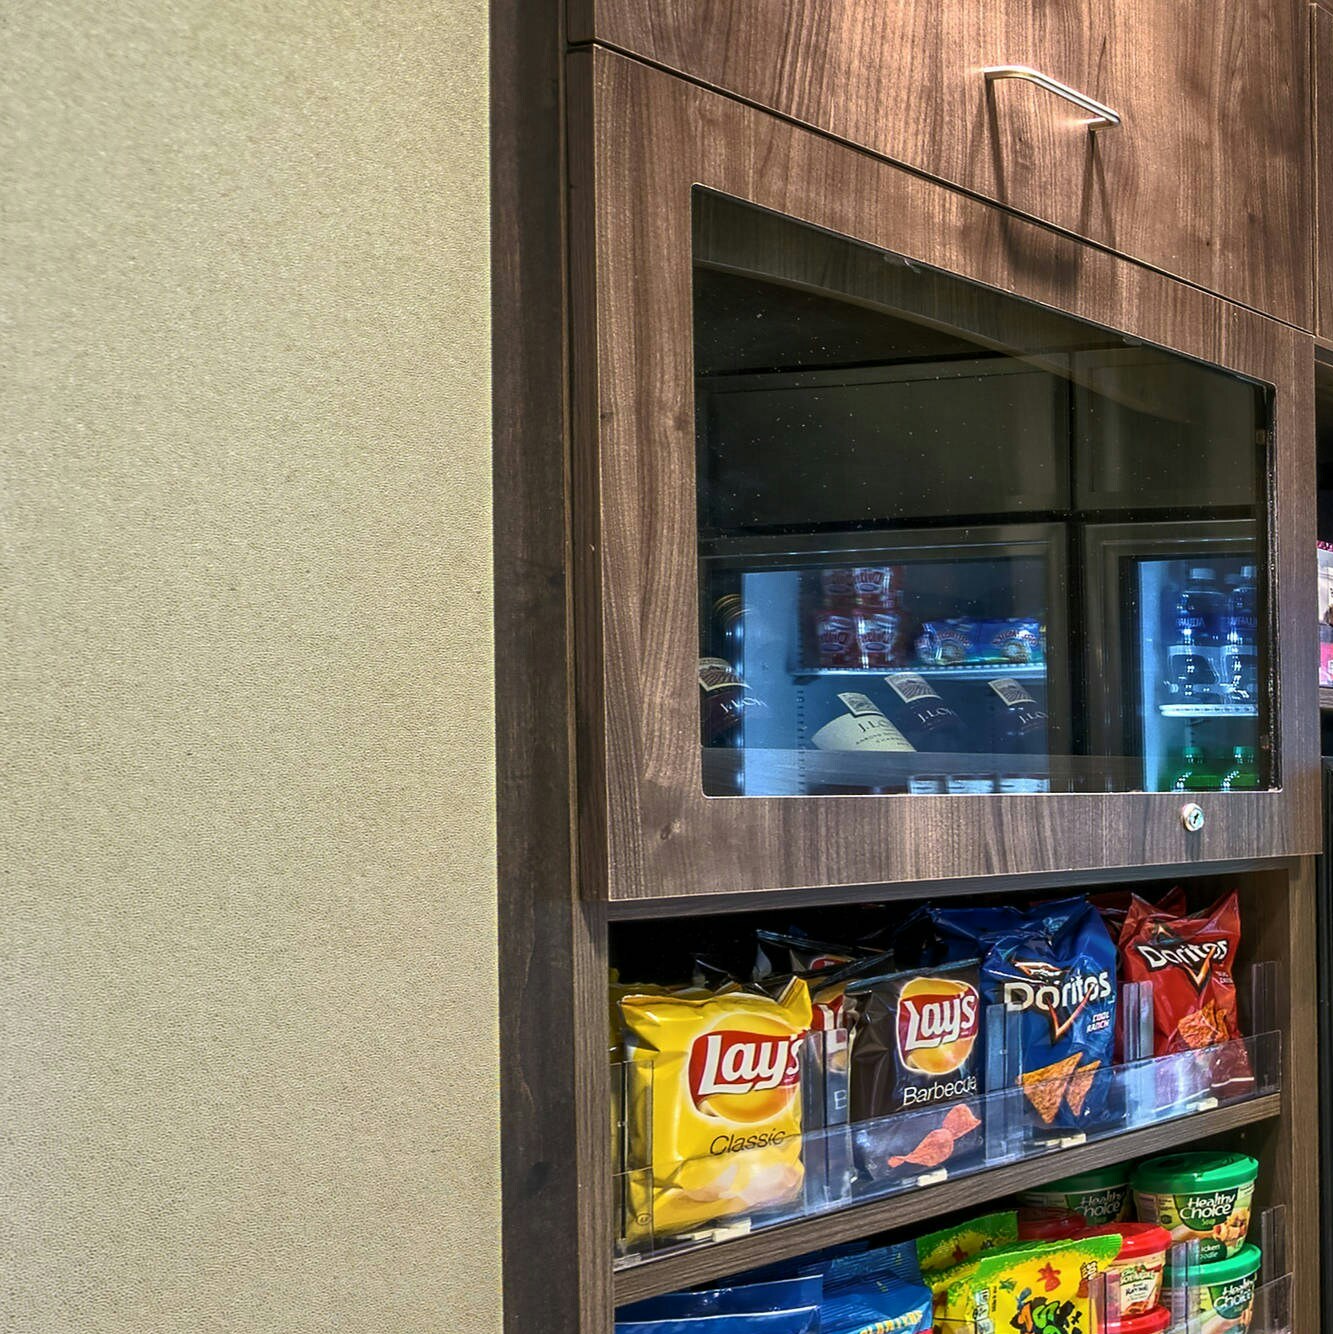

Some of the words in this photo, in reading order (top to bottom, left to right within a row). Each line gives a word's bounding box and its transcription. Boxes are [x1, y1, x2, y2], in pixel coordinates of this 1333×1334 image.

[1136, 938, 1228, 969] Doritos
[1003, 967, 1112, 1014] Doritos
[903, 994, 977, 1051] Lay's
[699, 1031, 804, 1096] Lay's
[902, 1074, 977, 1106] Barbecue
[709, 1128, 787, 1157] Classic
[1180, 1203, 1232, 1220] Choice
[1189, 1193, 1236, 1210] Healthy
